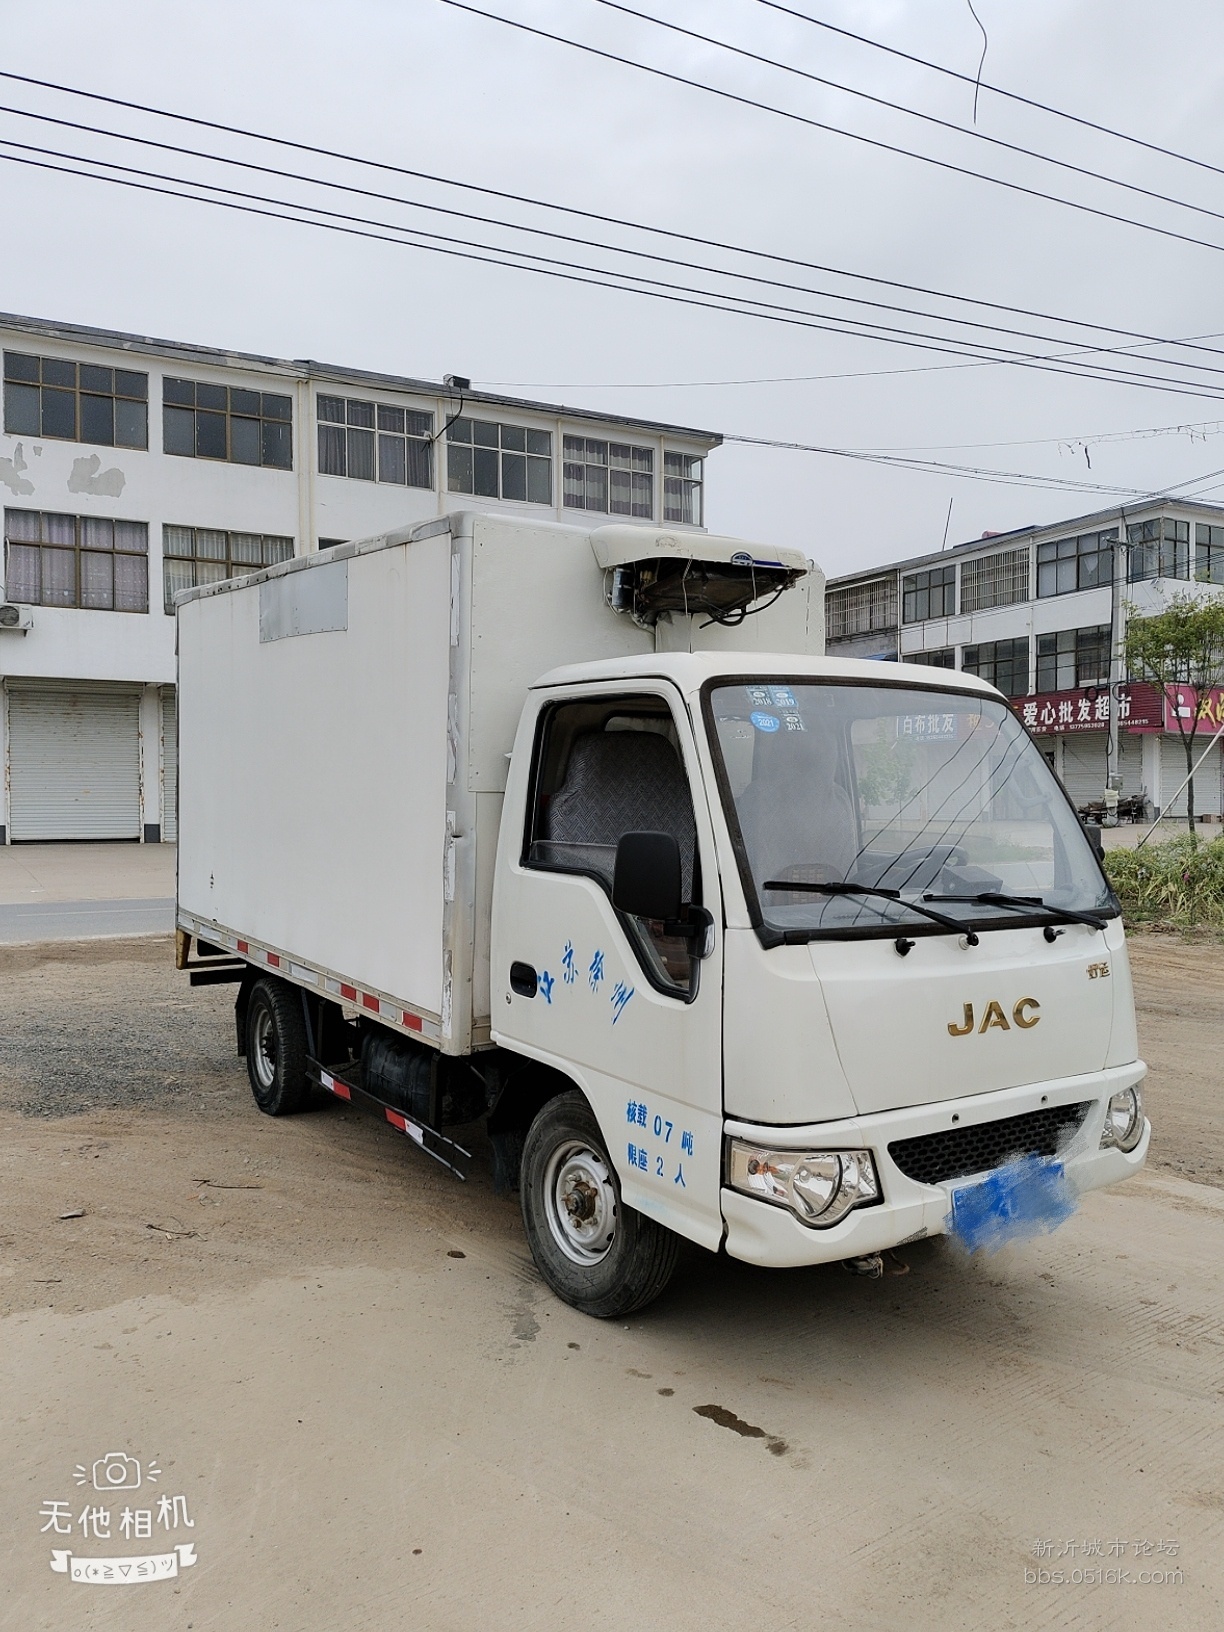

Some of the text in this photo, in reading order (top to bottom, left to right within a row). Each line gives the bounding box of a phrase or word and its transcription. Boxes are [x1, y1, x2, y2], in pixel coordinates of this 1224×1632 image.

[753, 697, 772, 706] 2018
[775, 698, 795, 706] 2019
[1022, 693, 1131, 726] 爱心批发超市
[758, 718, 774, 727] 2021
[786, 723, 805, 731] 2021
[947, 995, 1041, 1037] JAC
[626, 1099, 648, 1128] 核载
[681, 1131, 694, 1156] 吨
[656, 1155, 664, 1177] 2
[674, 1163, 686, 1188] 人
